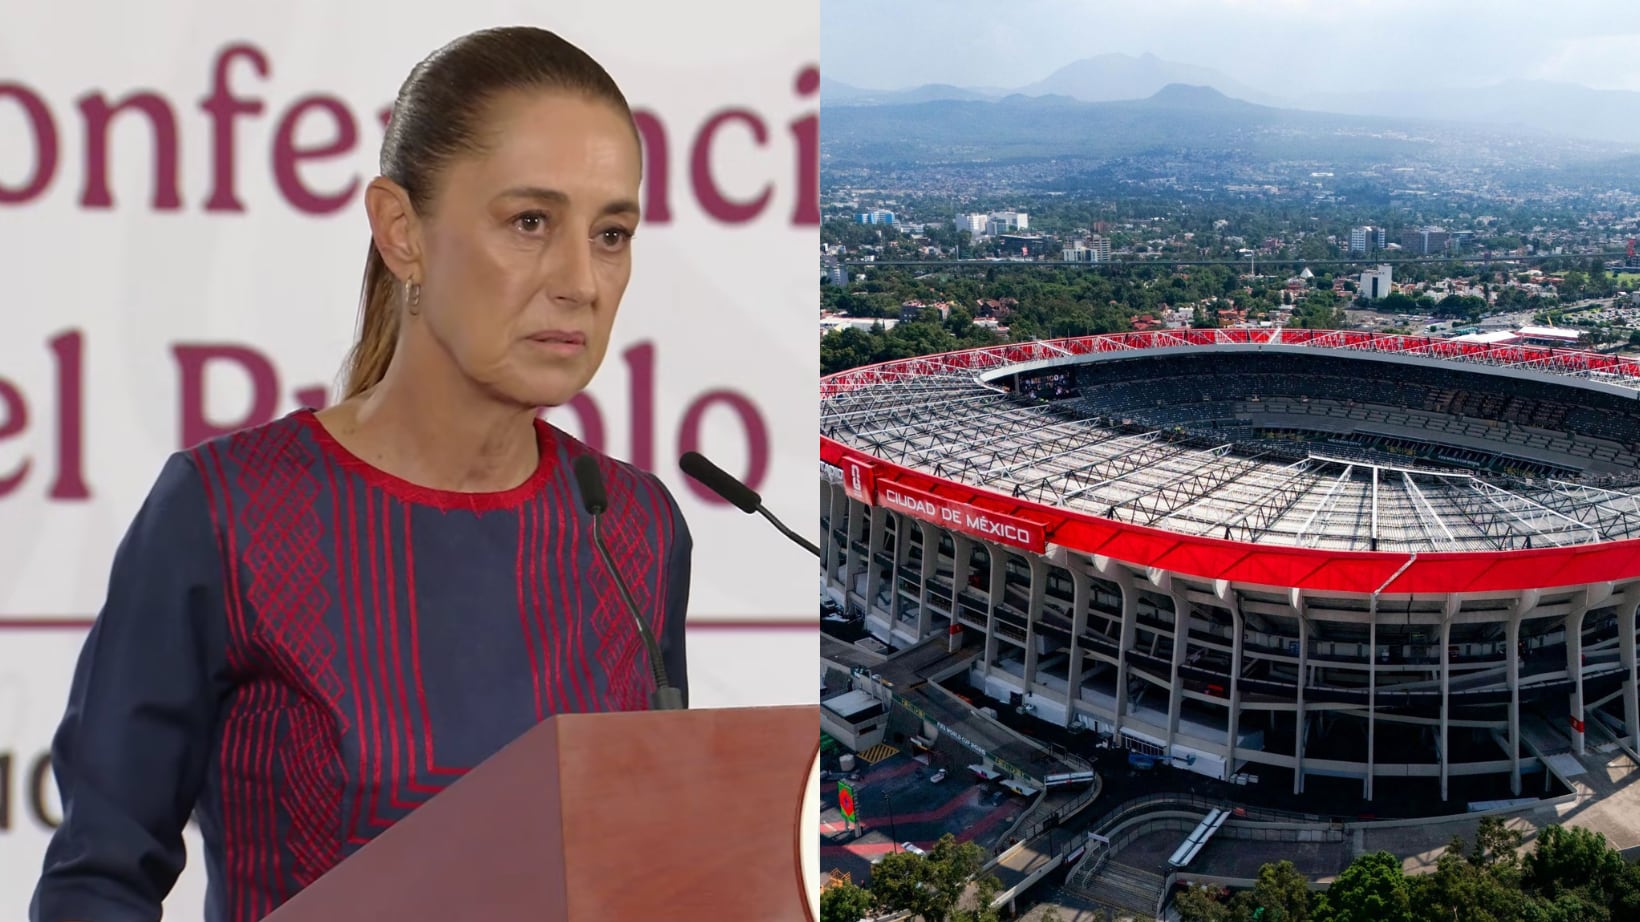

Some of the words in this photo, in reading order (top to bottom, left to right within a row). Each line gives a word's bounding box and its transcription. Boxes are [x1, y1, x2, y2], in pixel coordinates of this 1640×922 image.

[886, 489, 936, 516] CIUDAD
[941, 507, 962, 525] DE
[966, 513, 1031, 543] MÉXICO
